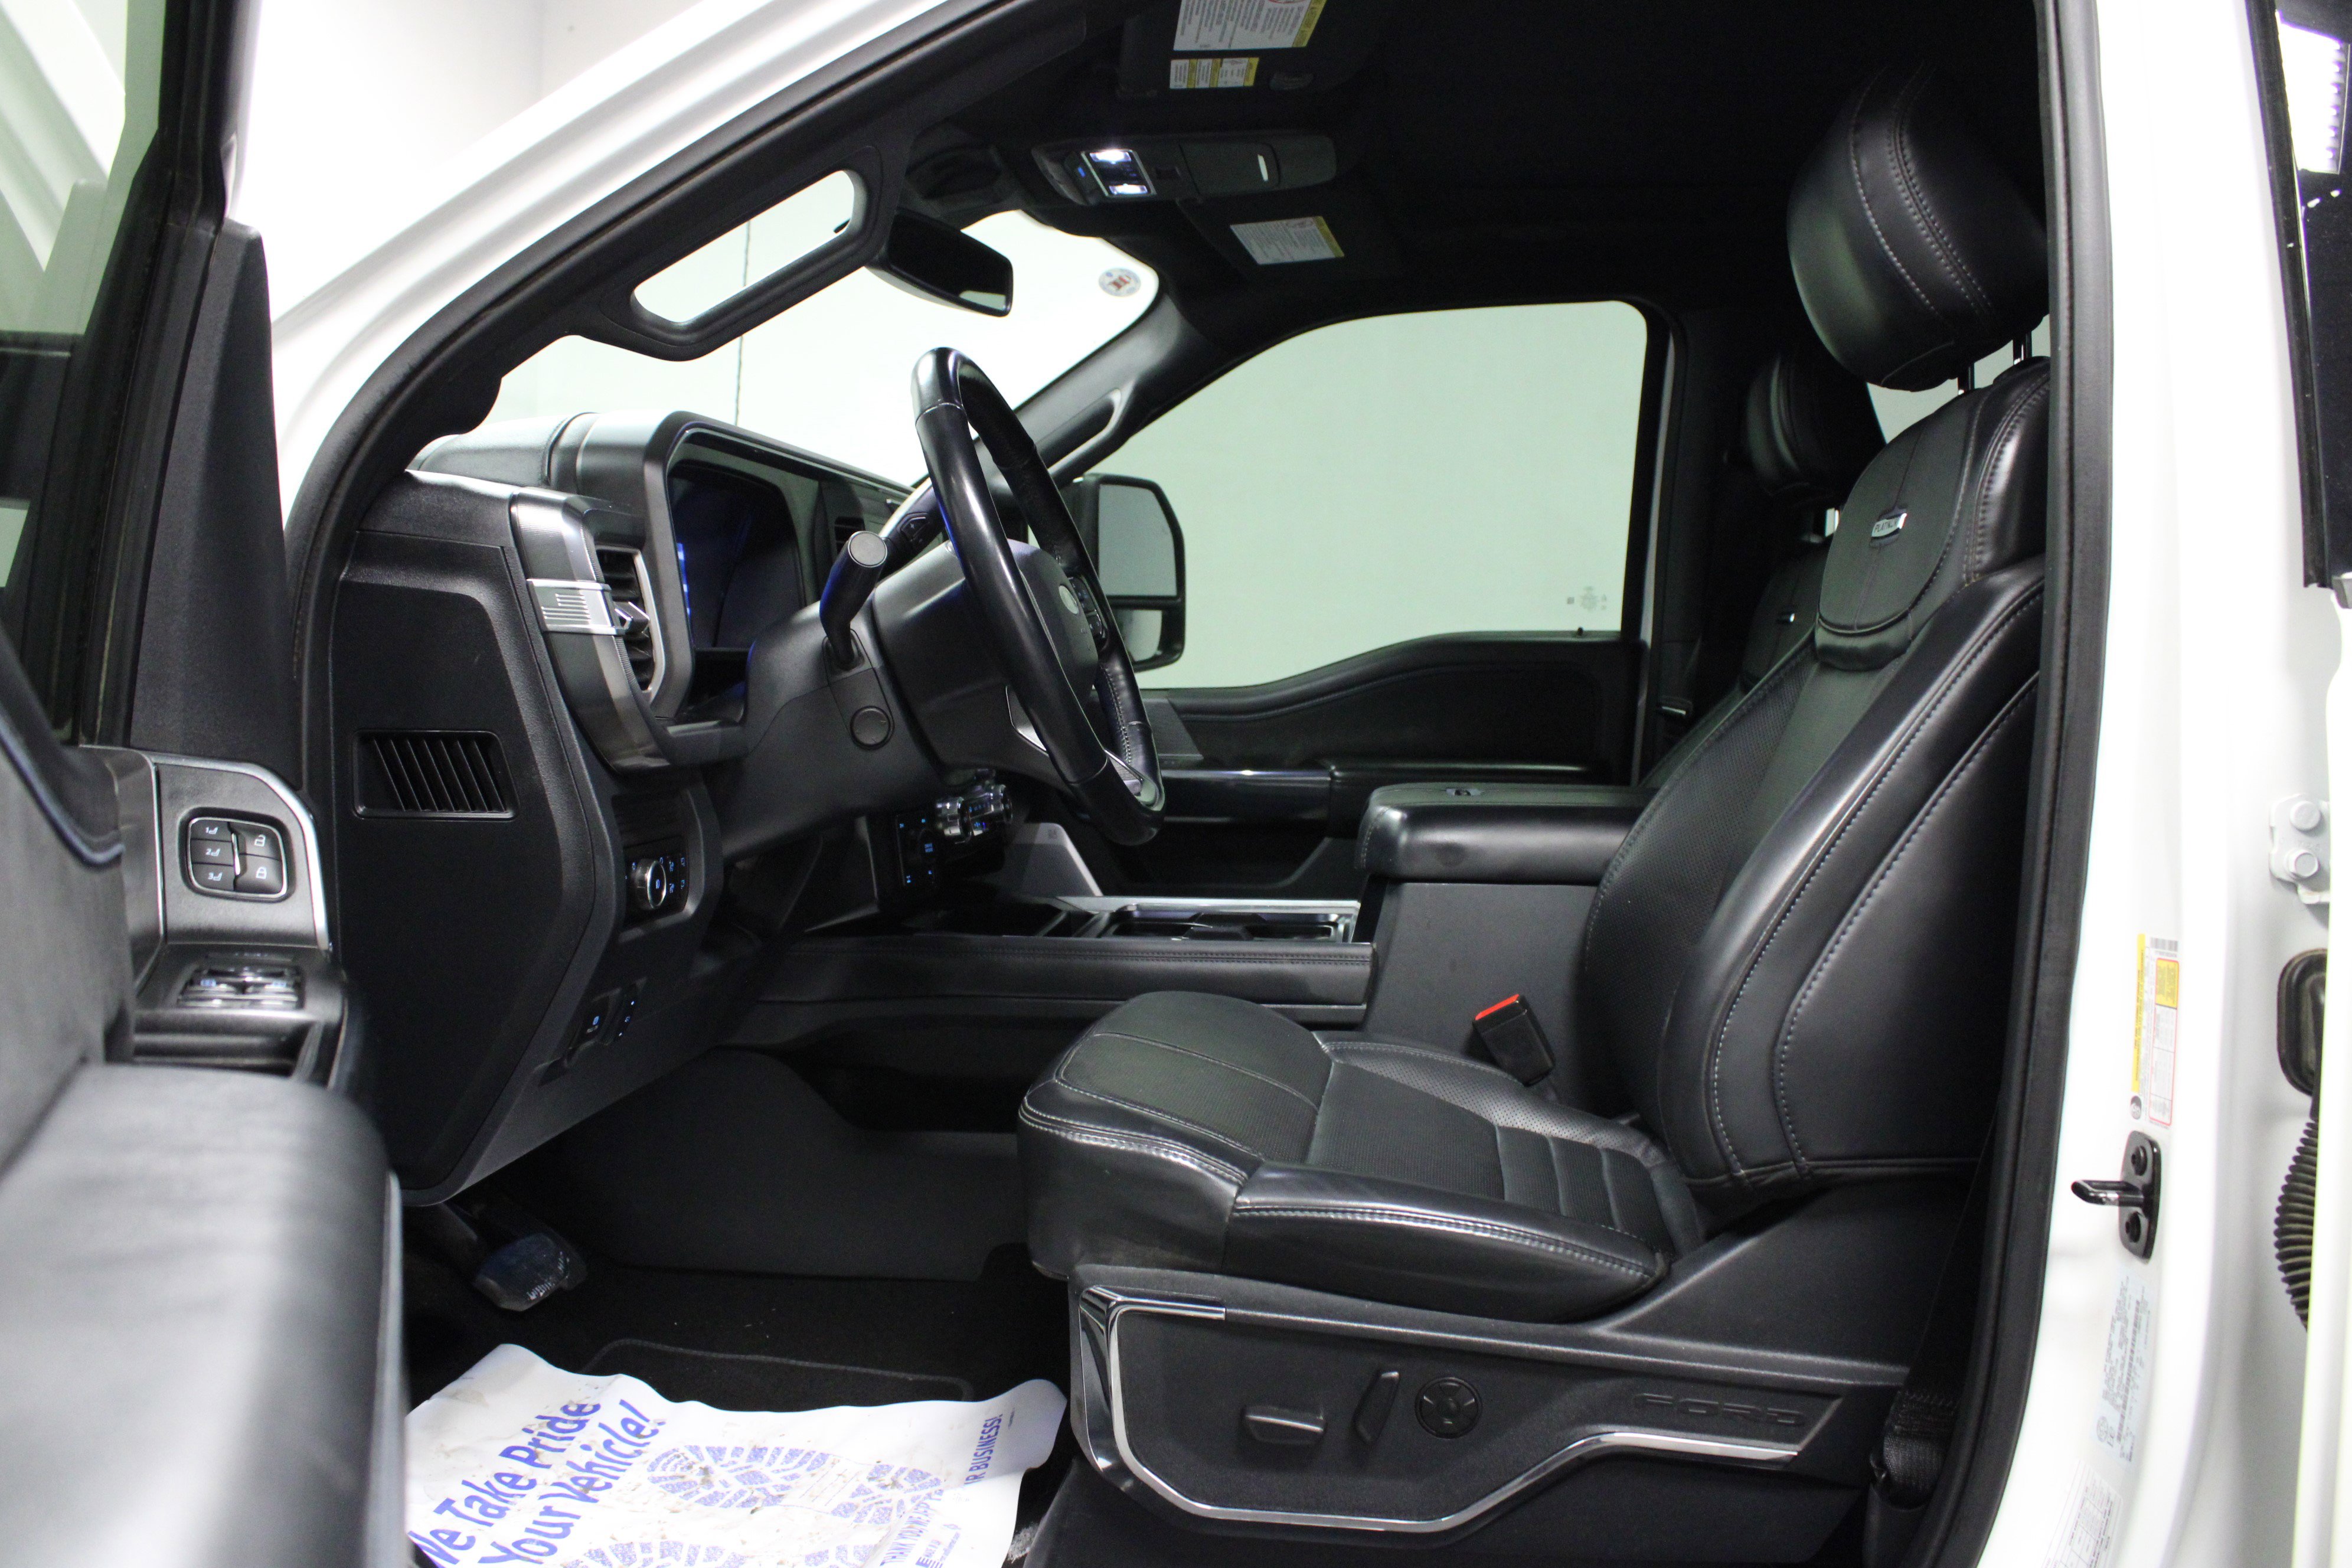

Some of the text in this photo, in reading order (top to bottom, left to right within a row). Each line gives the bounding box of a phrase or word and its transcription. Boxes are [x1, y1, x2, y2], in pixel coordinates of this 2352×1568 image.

[968, 1413, 1003, 1472] BUSINESS!
[1633, 1392, 1805, 1426] FORD
[434, 1472, 538, 1527] Take
[499, 1403, 601, 1469] Pride
[478, 1399, 666, 1564] Your Vehicle!
